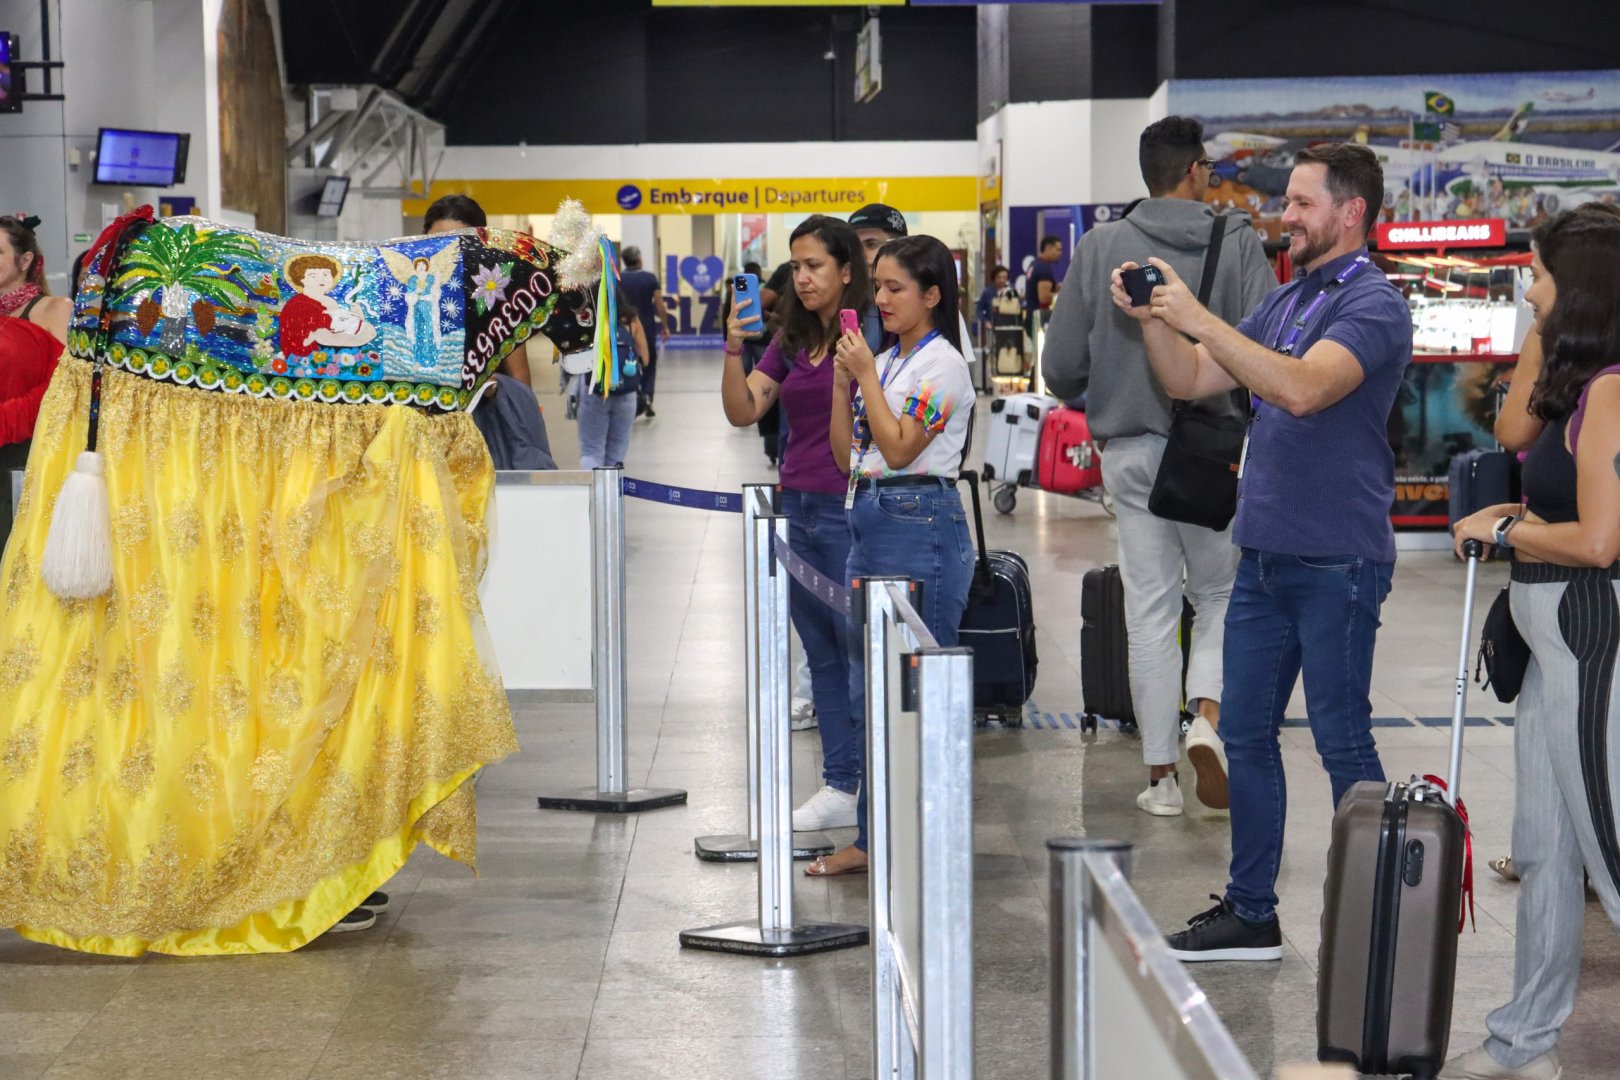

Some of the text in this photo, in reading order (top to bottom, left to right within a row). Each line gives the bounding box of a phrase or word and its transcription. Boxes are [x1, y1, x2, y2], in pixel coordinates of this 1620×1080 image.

[650, 187, 865, 208] Embarque Departures
[666, 255, 678, 293] I
[461, 271, 552, 390] SEGREDO
